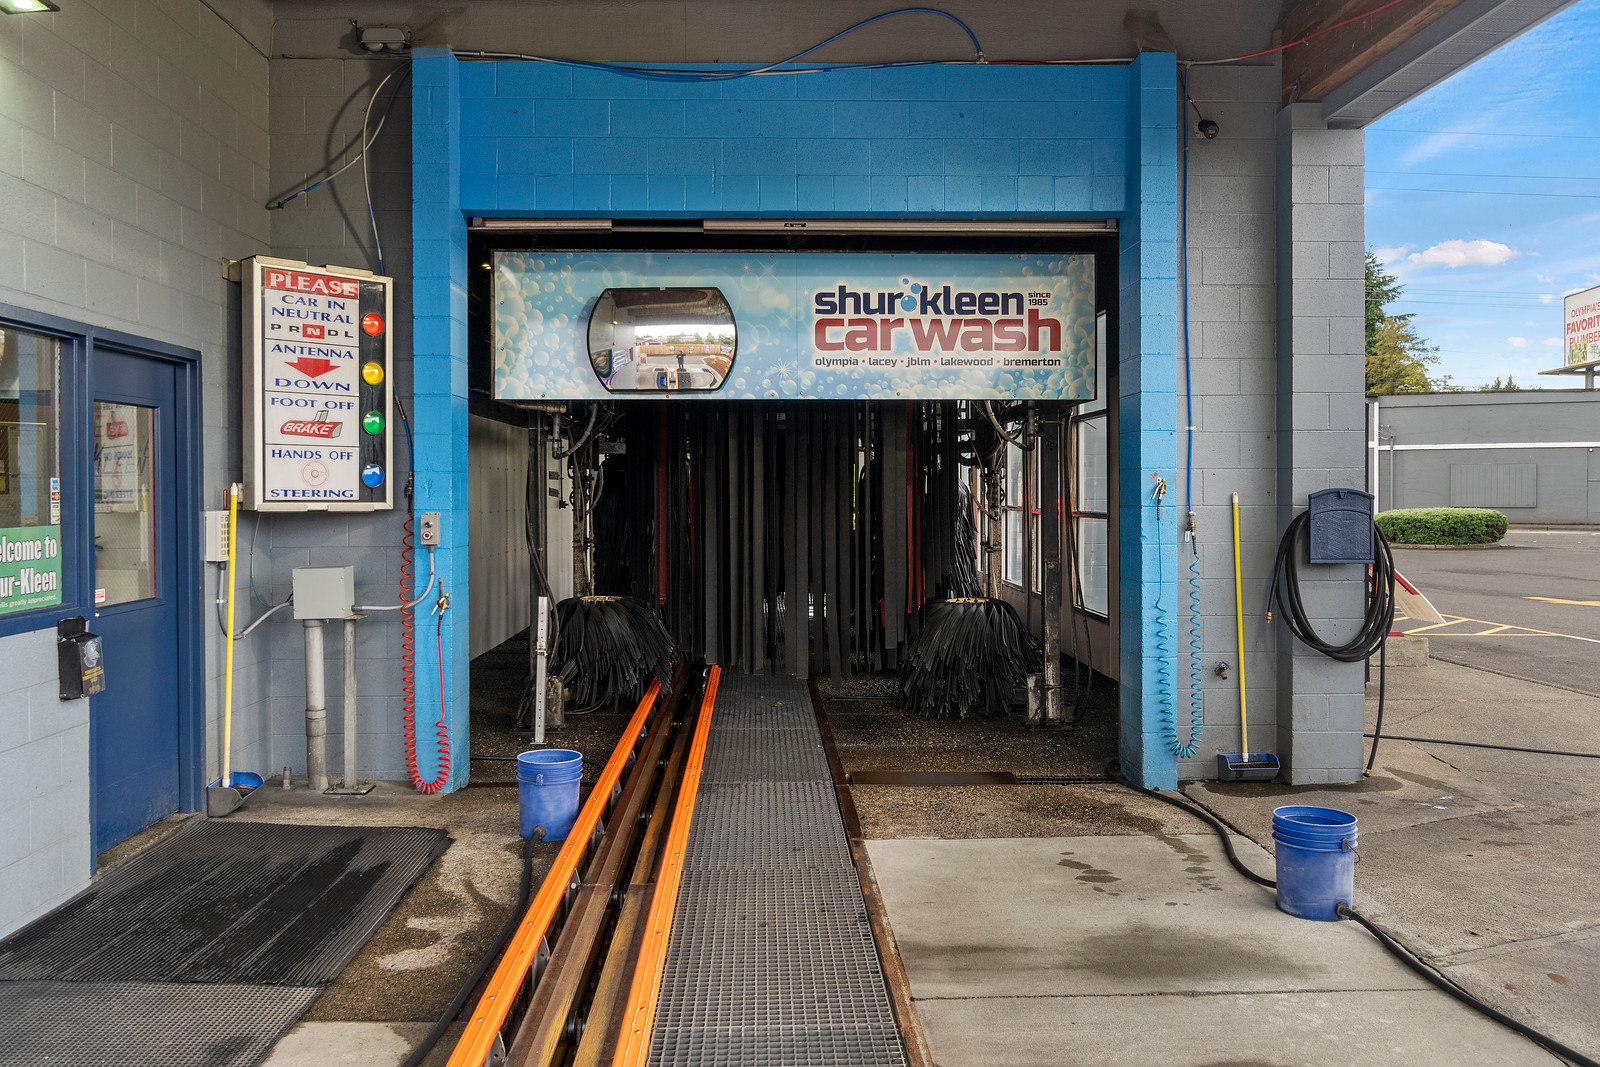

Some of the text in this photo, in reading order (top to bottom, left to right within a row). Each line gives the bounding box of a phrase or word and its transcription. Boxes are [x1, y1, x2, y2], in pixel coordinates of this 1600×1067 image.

[270, 272, 356, 297] PLEASE
[281, 294, 346, 311] CAR IN
[814, 285, 1024, 315] shur kleen
[271, 307, 354, 325] NEUTRAL
[814, 308, 1061, 352] car wash
[271, 343, 354, 360] ANTENNA
[815, 357, 1061, 367] olympia lacey jblm lakewood bremerton
[274, 378, 351, 391] DOWN
[271, 397, 355, 410] FOOT OFF
[283, 422, 333, 435] BRAKE
[271, 449, 354, 460] HANDS OFF
[271, 488, 354, 498] STEERING
[0, 535, 57, 563] lcome to
